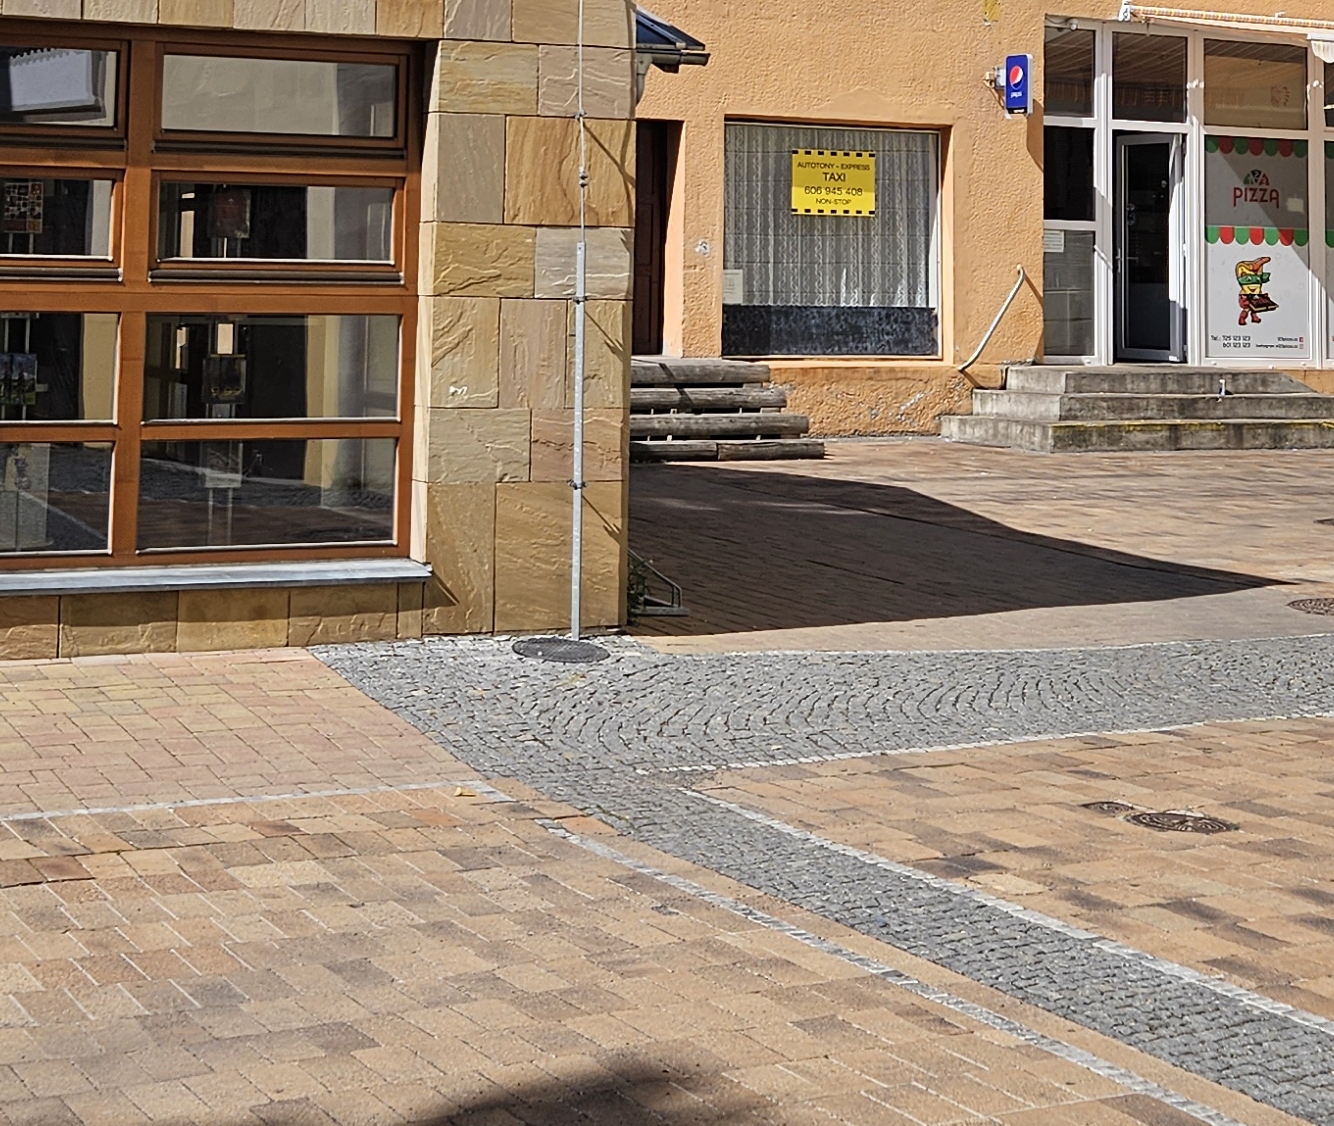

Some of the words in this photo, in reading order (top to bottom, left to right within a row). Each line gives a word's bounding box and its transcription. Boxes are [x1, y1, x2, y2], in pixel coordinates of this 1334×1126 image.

[840, 163, 870, 171] EXPRESS
[822, 172, 846, 182] TAXI
[804, 186, 823, 195] 606
[825, 187, 843, 195] 945
[845, 187, 863, 196] 408
[1233, 186, 1279, 208] PIZZA
